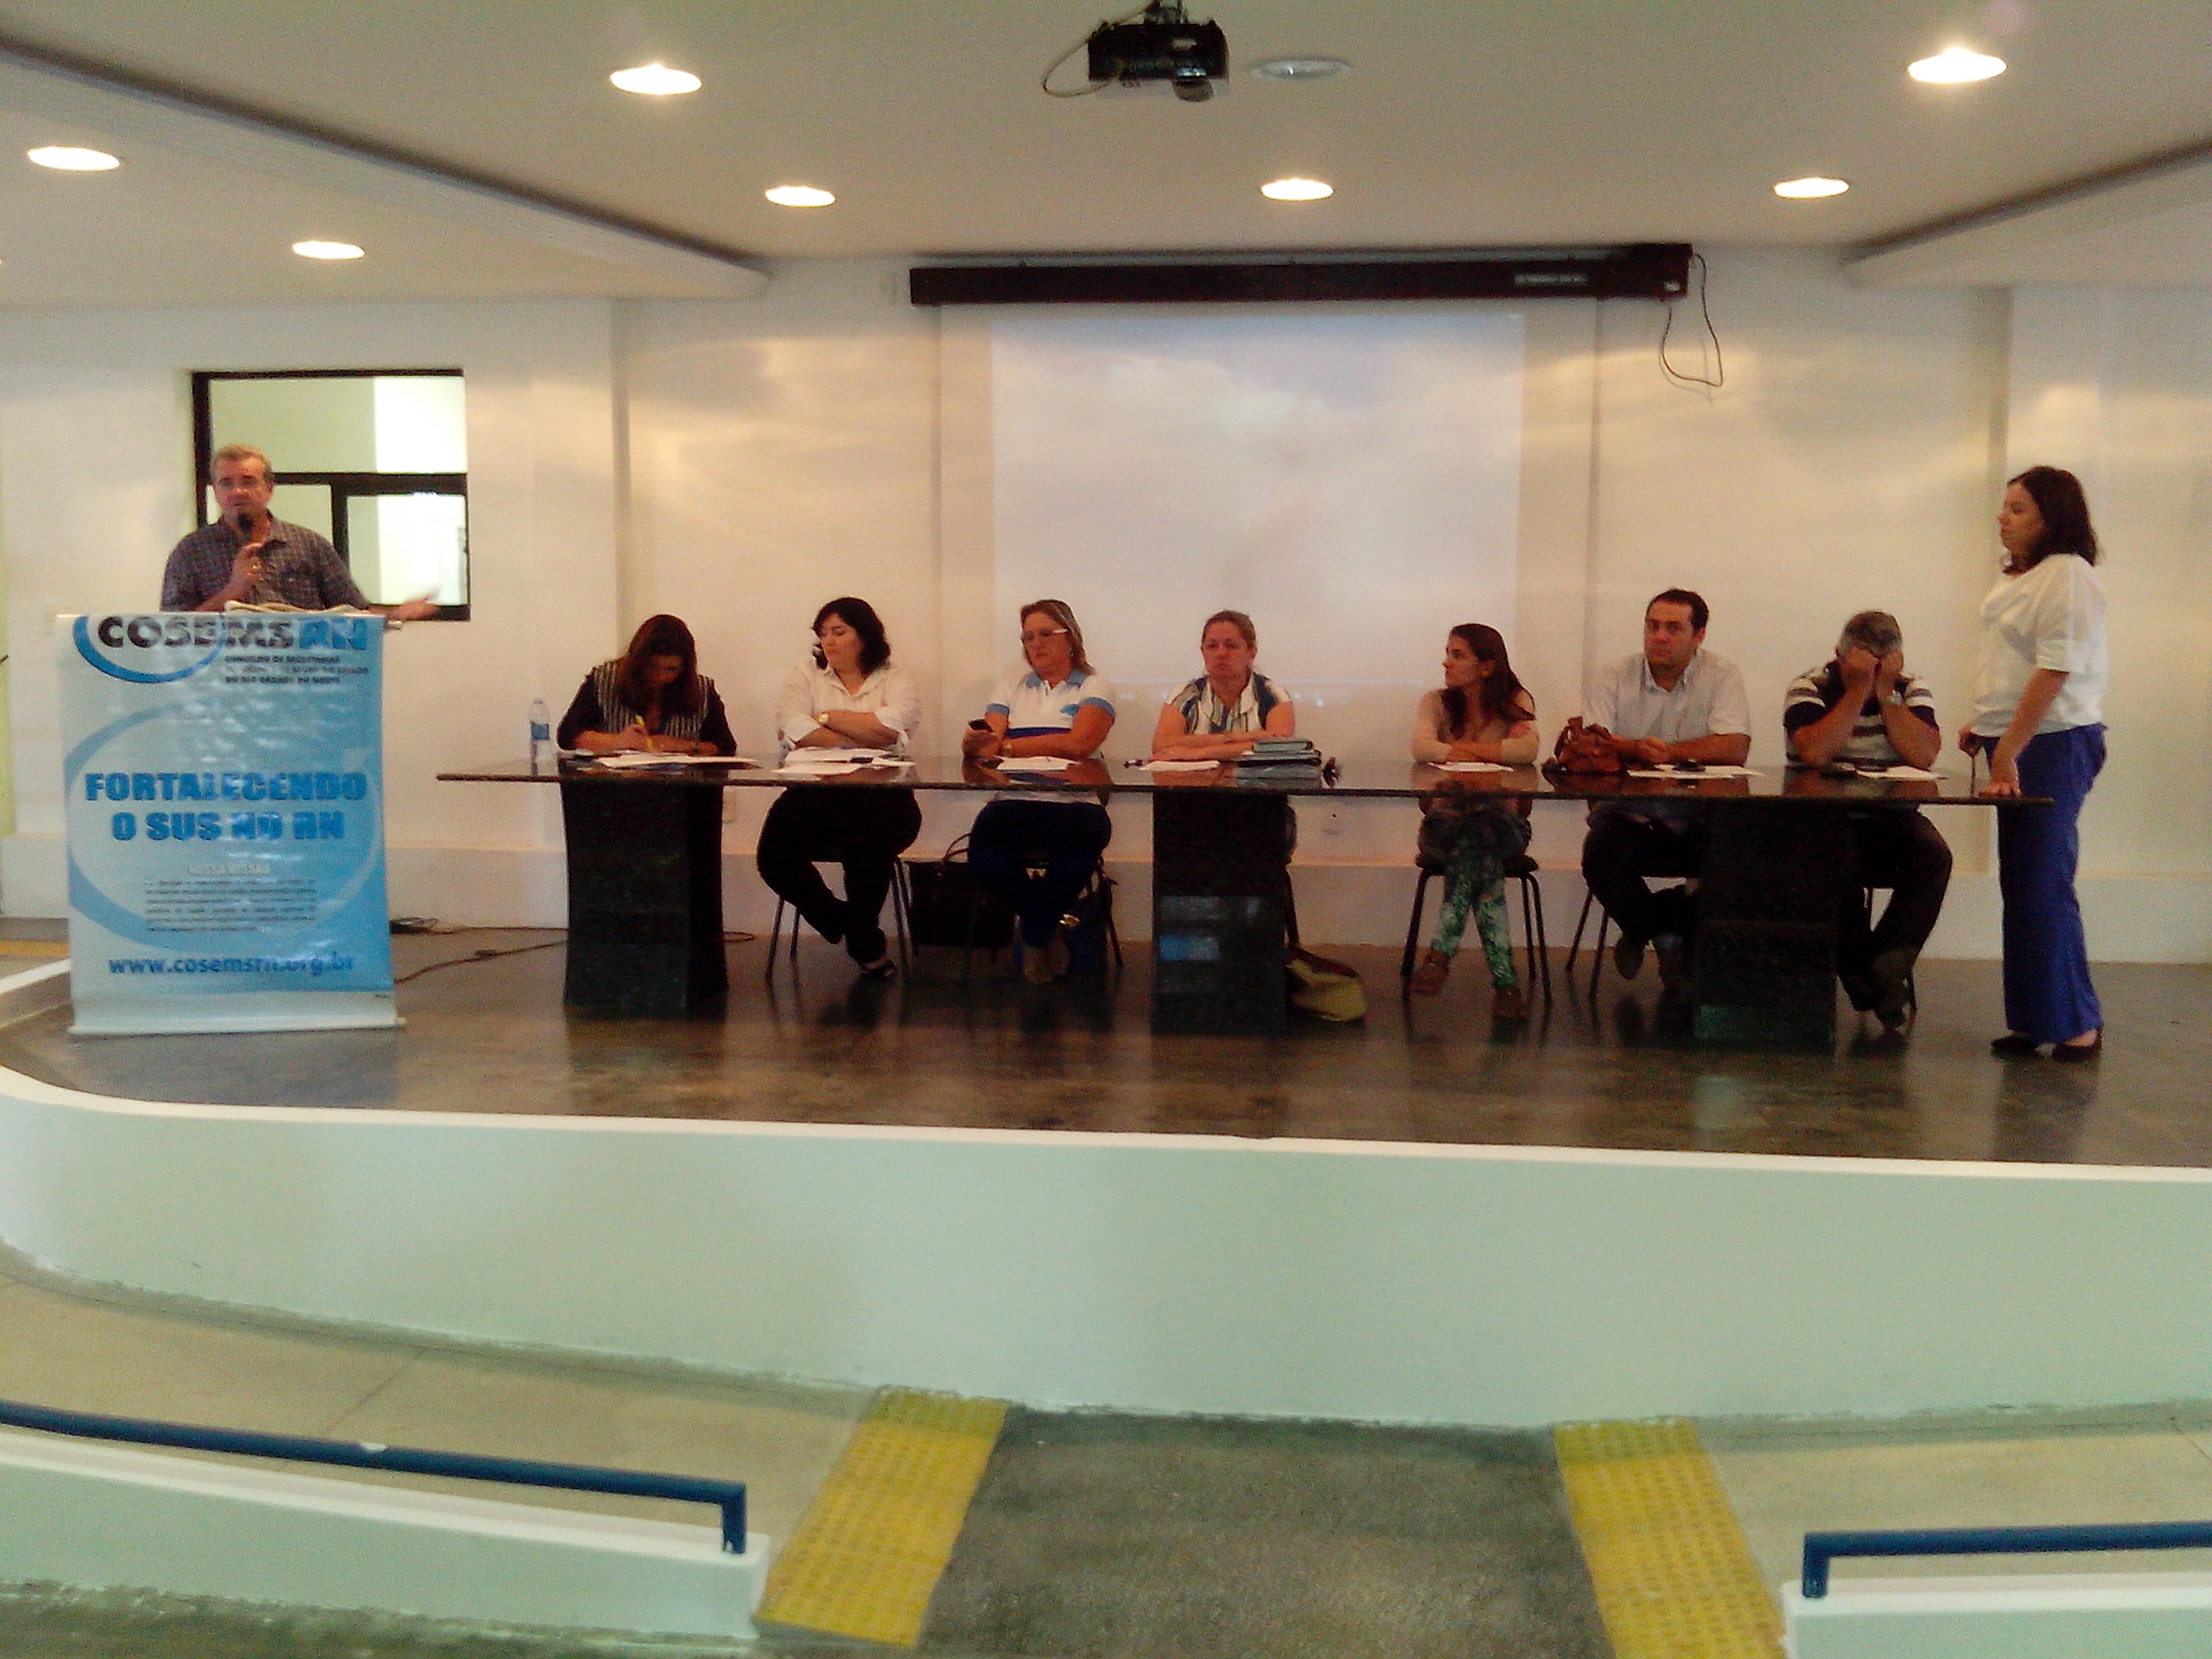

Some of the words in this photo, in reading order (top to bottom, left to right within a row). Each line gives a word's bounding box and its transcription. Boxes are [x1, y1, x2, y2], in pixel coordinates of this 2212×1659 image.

[85, 772, 367, 800] FORTALECENDO
[112, 812, 137, 841] O
[146, 812, 222, 841] SUS
[293, 812, 345, 840] RN
